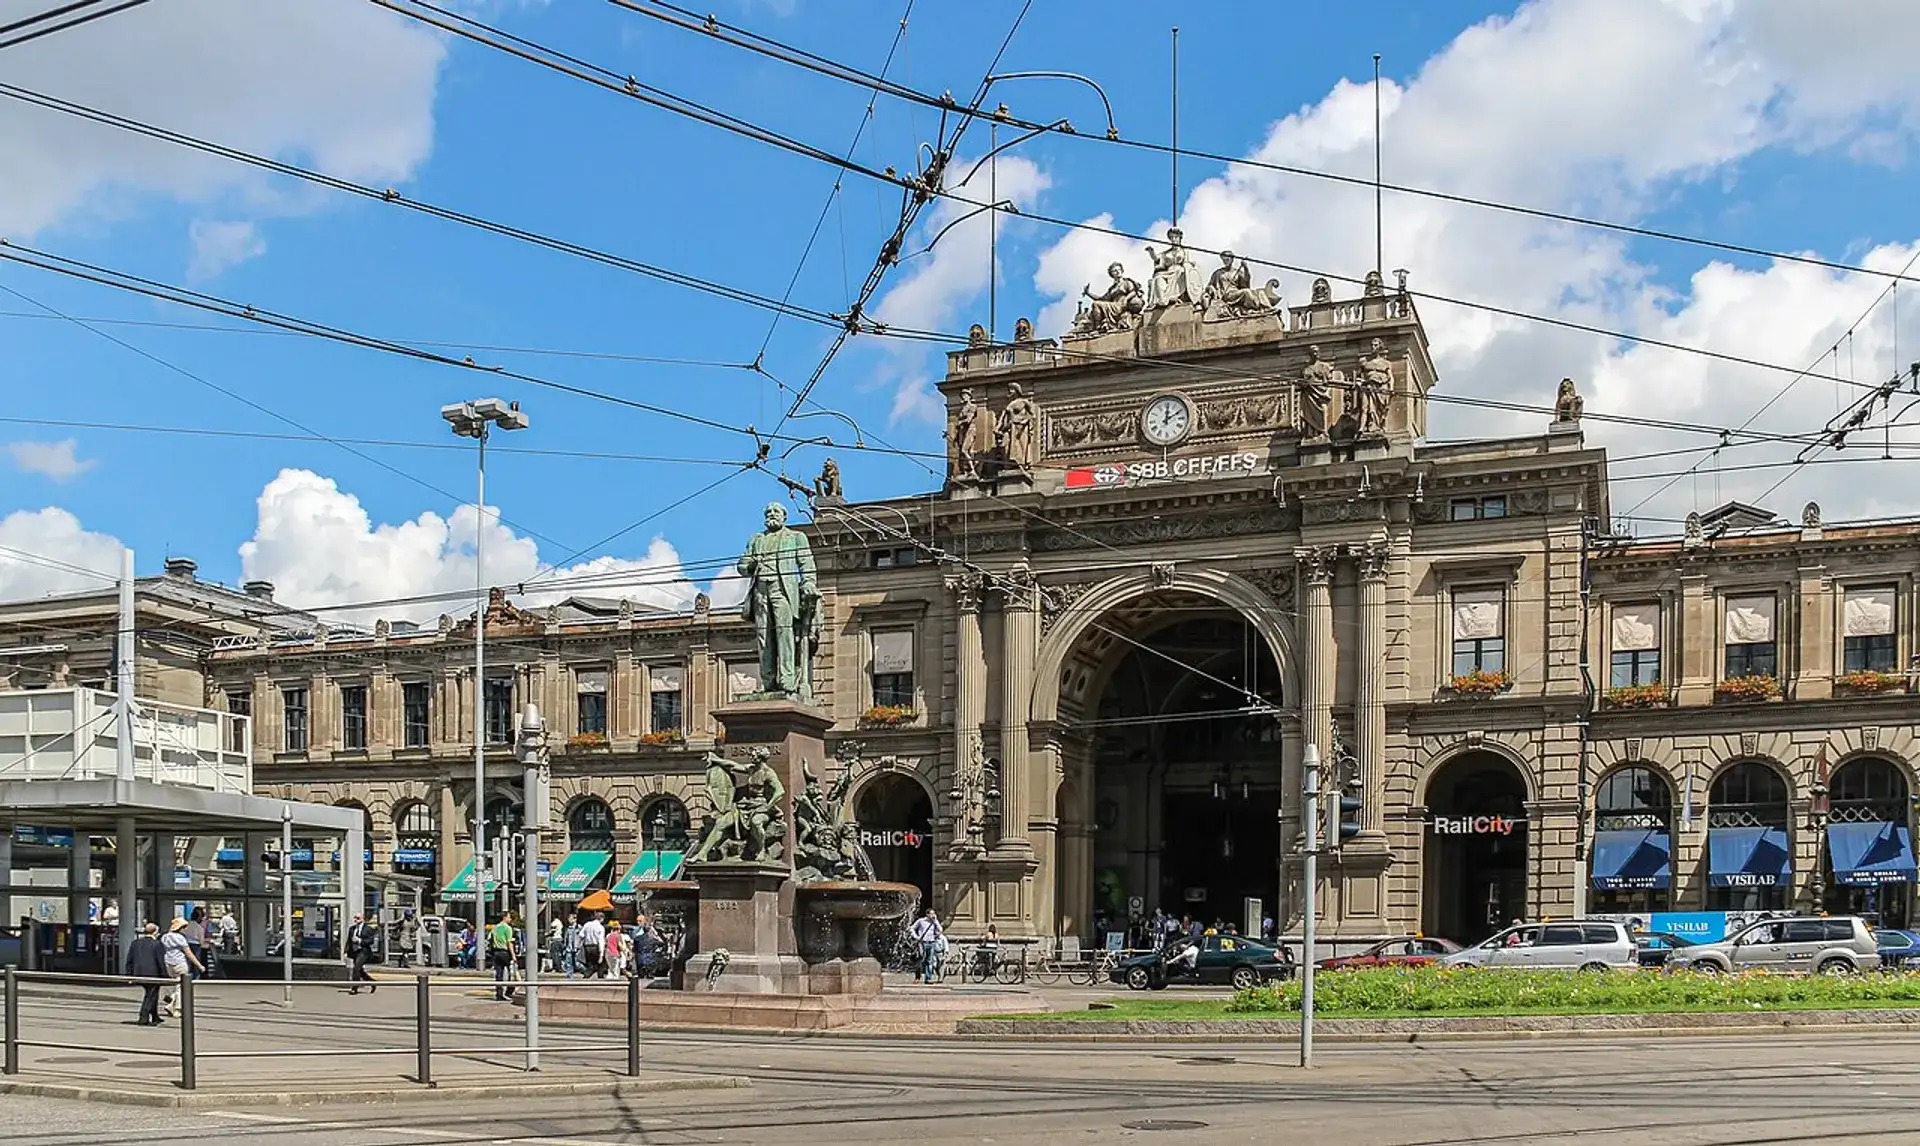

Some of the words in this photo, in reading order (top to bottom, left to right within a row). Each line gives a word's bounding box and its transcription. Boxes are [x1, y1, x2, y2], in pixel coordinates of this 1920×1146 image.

[1129, 461, 1169, 480] SBB
[1433, 815, 1514, 835] RailCity
[860, 829, 924, 849] RailCity
[1725, 874, 1776, 886] VISILAB
[1666, 922, 1709, 931] VISILAB
